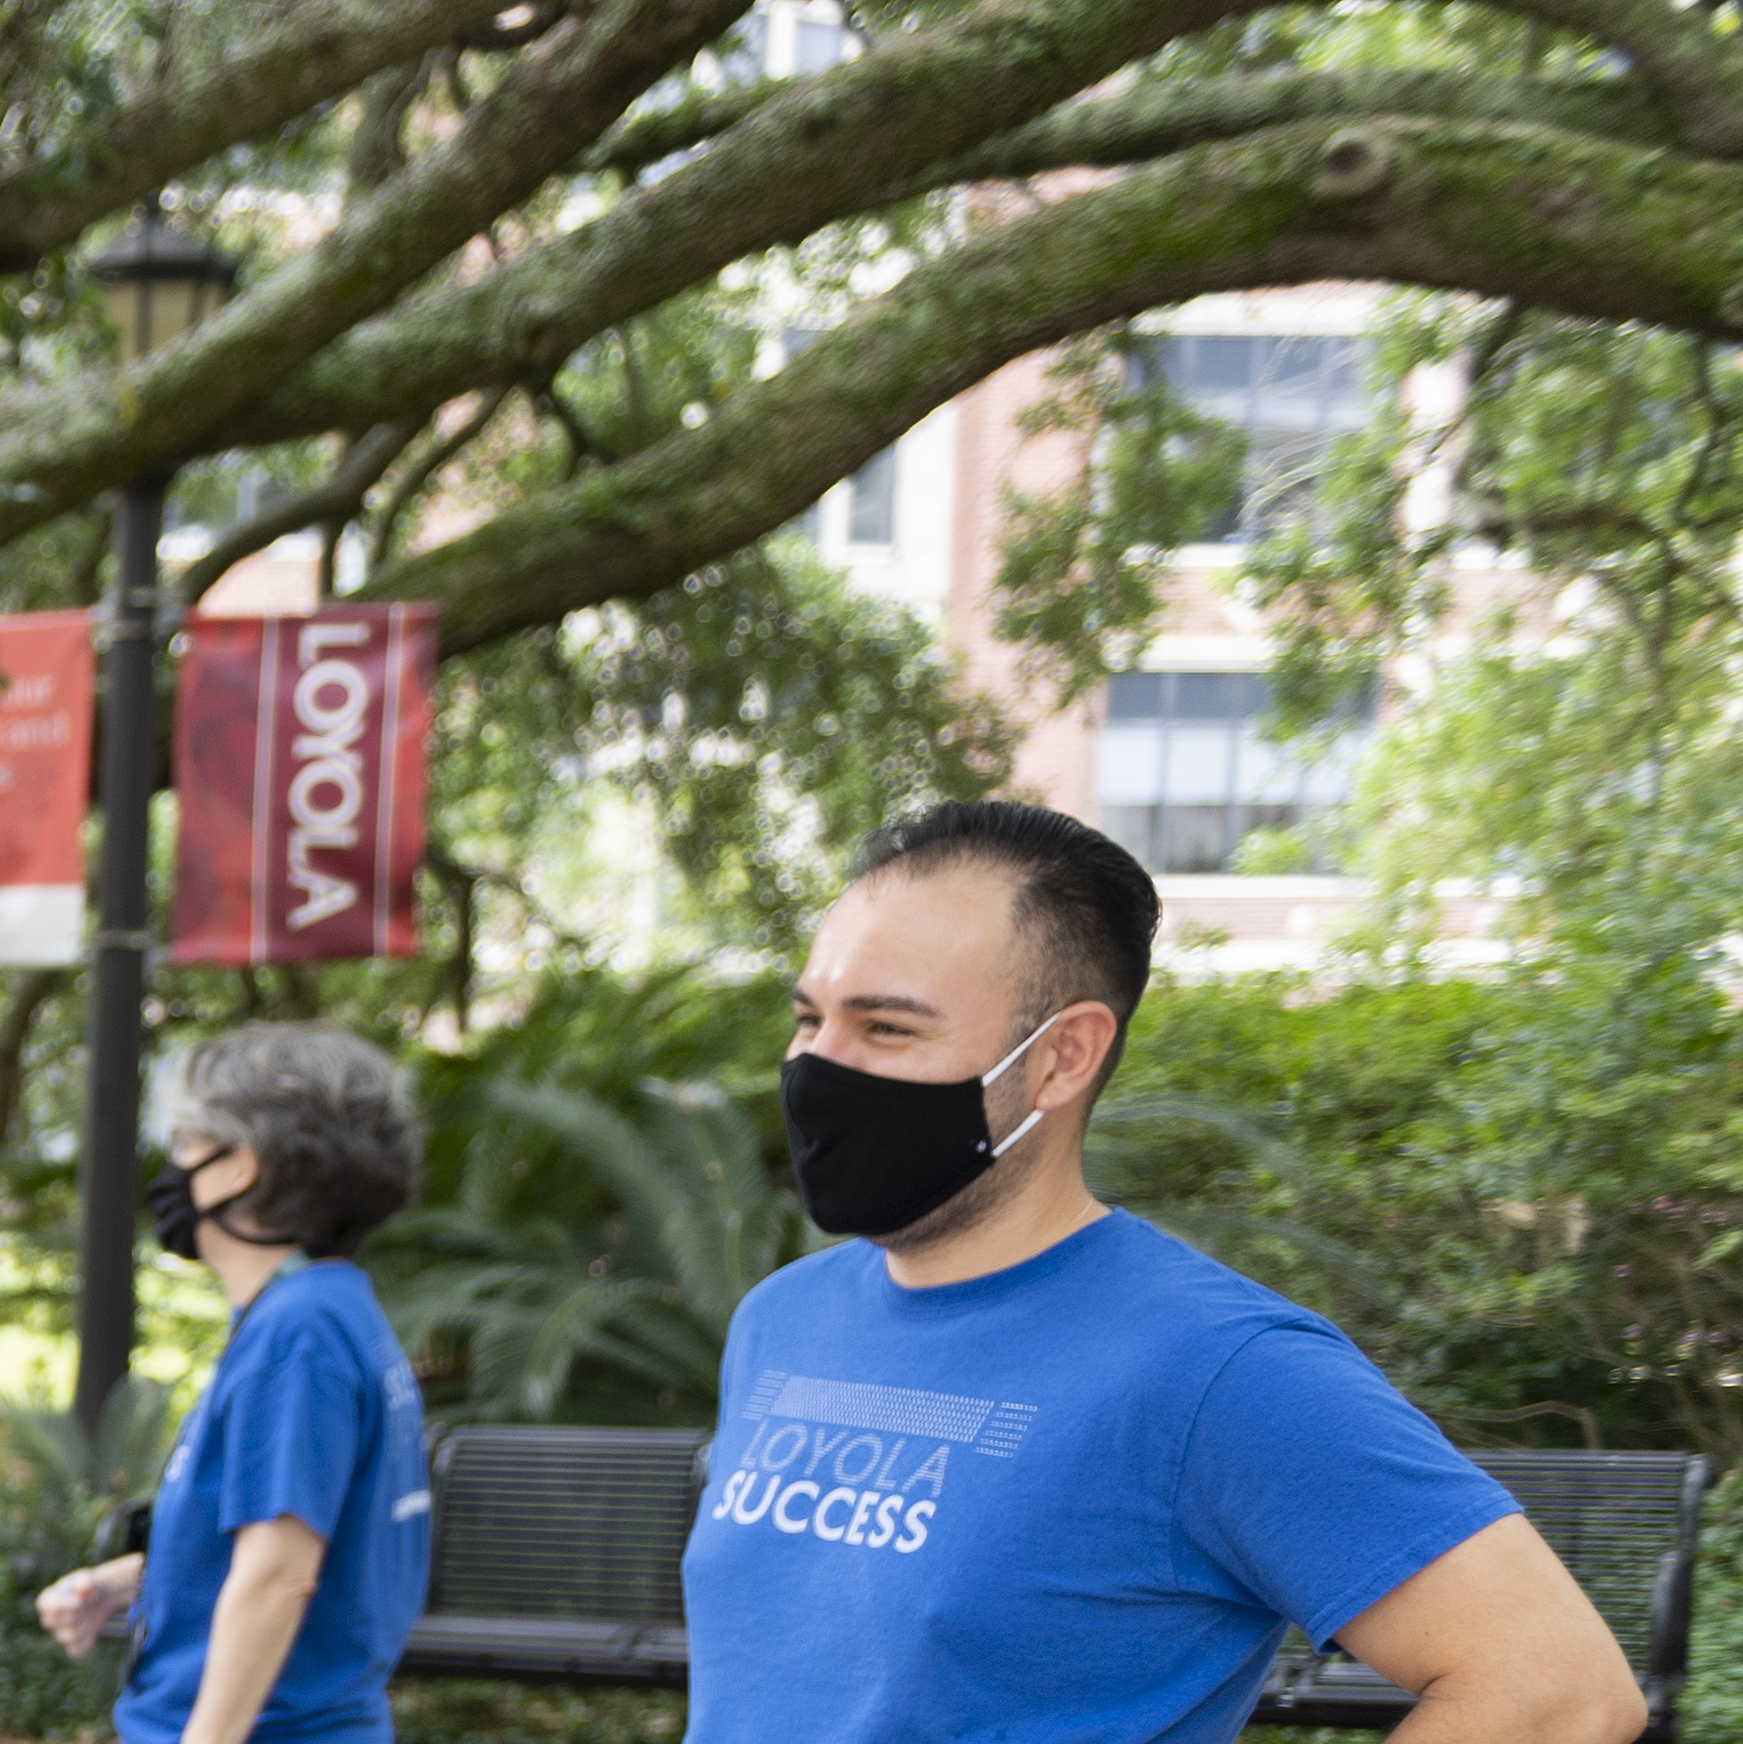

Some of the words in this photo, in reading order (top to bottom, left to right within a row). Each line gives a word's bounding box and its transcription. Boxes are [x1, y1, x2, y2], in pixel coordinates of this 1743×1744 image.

[286, 621, 371, 931] LOYOLA
[741, 1419, 951, 1498] LOYOLA
[713, 1469, 937, 1554] SUCCESS
